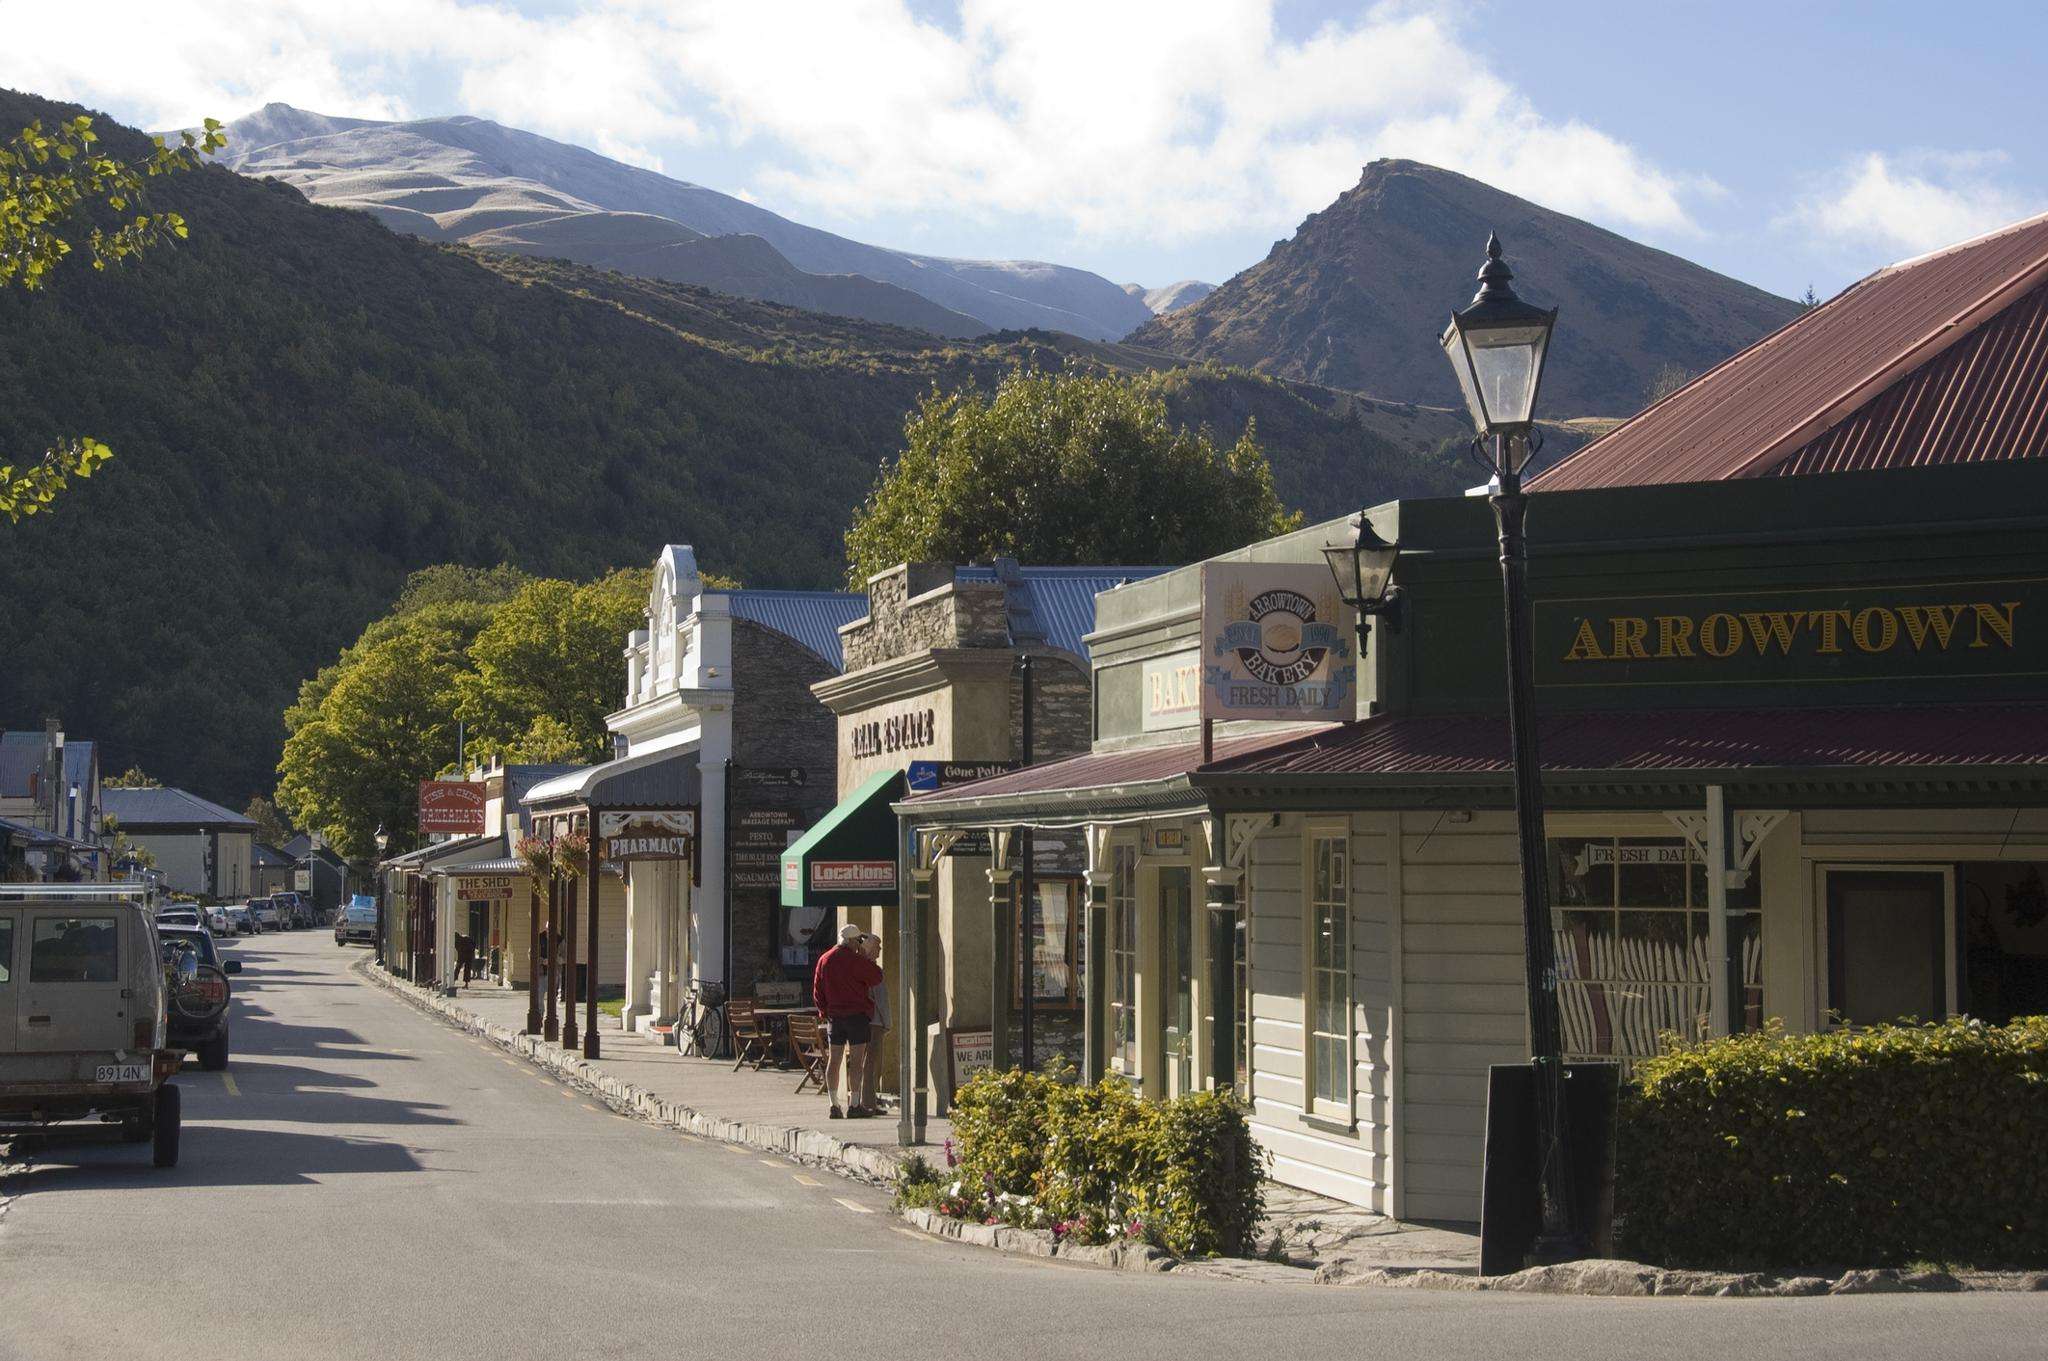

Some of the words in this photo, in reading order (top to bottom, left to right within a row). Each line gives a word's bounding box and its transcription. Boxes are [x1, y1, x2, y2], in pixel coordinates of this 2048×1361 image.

[1250, 592, 1316, 619] ARROWTOWN
[1564, 602, 2020, 661] ARROWTOWN
[1245, 651, 1319, 685] BAKERY
[1229, 686, 1280, 706] FRESH
[1285, 686, 1332, 708] DAILY
[944, 766, 974, 778] Gone
[749, 832, 773, 841] PESTO
[610, 836, 686, 859] PHARMACY
[1595, 848, 1649, 862] FRESH
[813, 863, 894, 881] Locations
[458, 878, 481, 889] THE
[482, 877, 511, 888] SHED
[957, 1050, 973, 1062] WE
